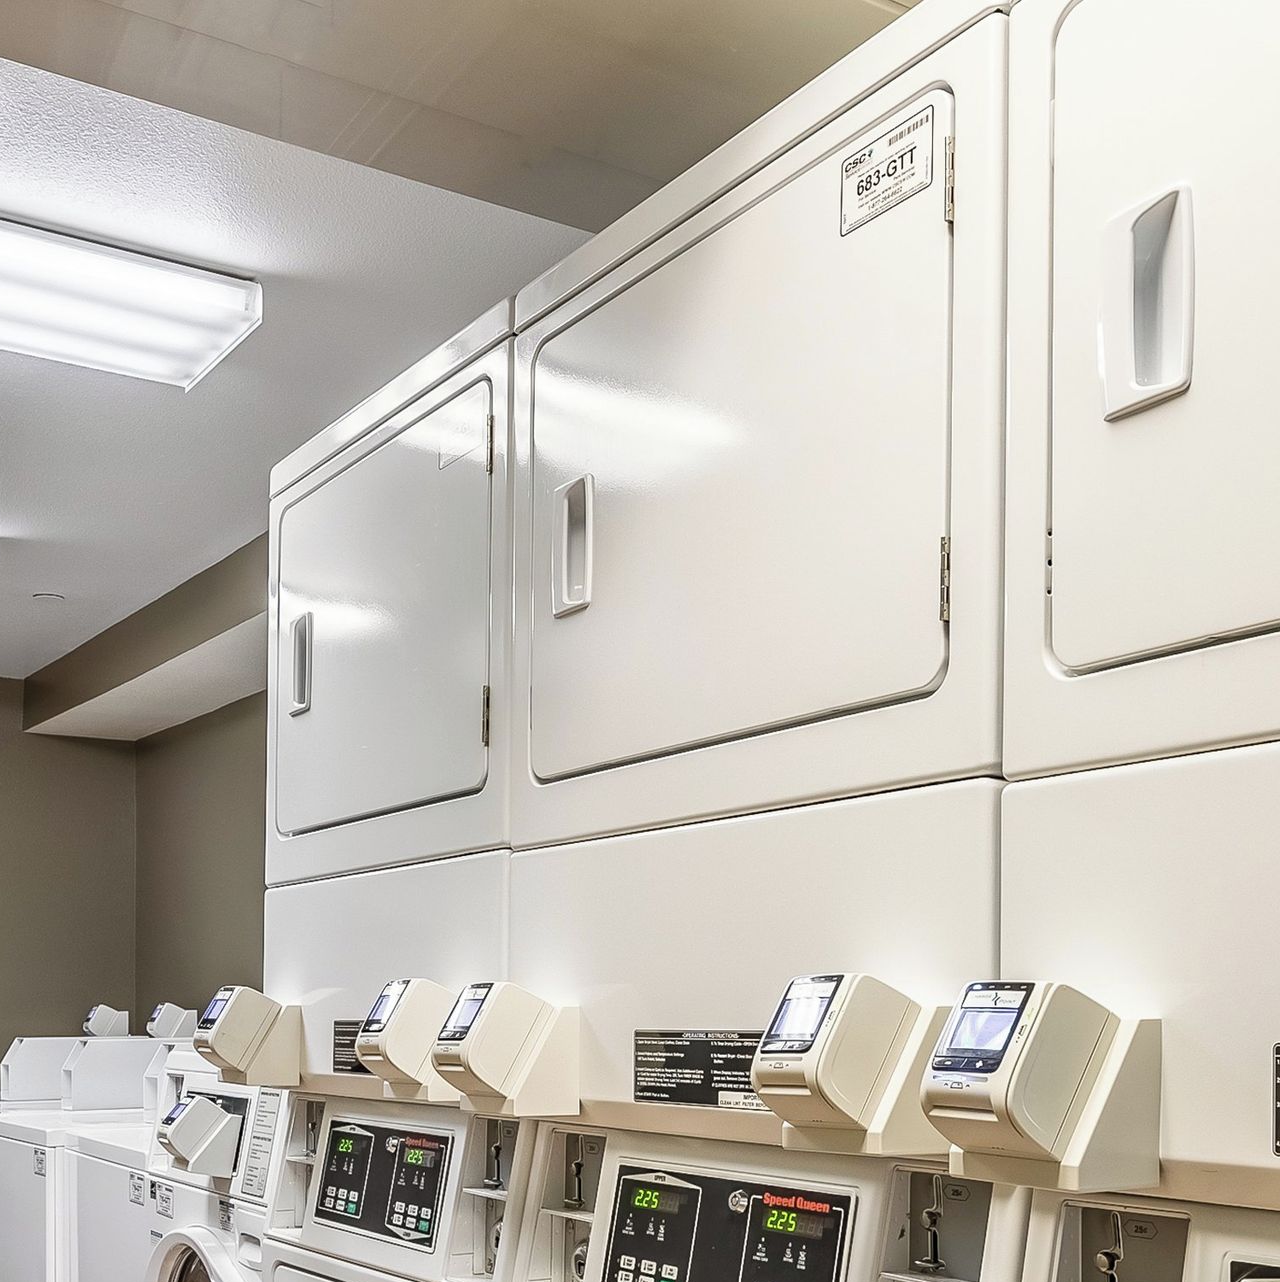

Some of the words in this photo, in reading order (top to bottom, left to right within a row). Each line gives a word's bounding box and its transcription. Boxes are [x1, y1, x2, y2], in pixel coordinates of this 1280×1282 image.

[845, 153, 866, 173] CSC
[857, 146, 917, 196] 683-GTT
[763, 1192, 795, 1206] Speed
[796, 1197, 830, 1213] Queen
